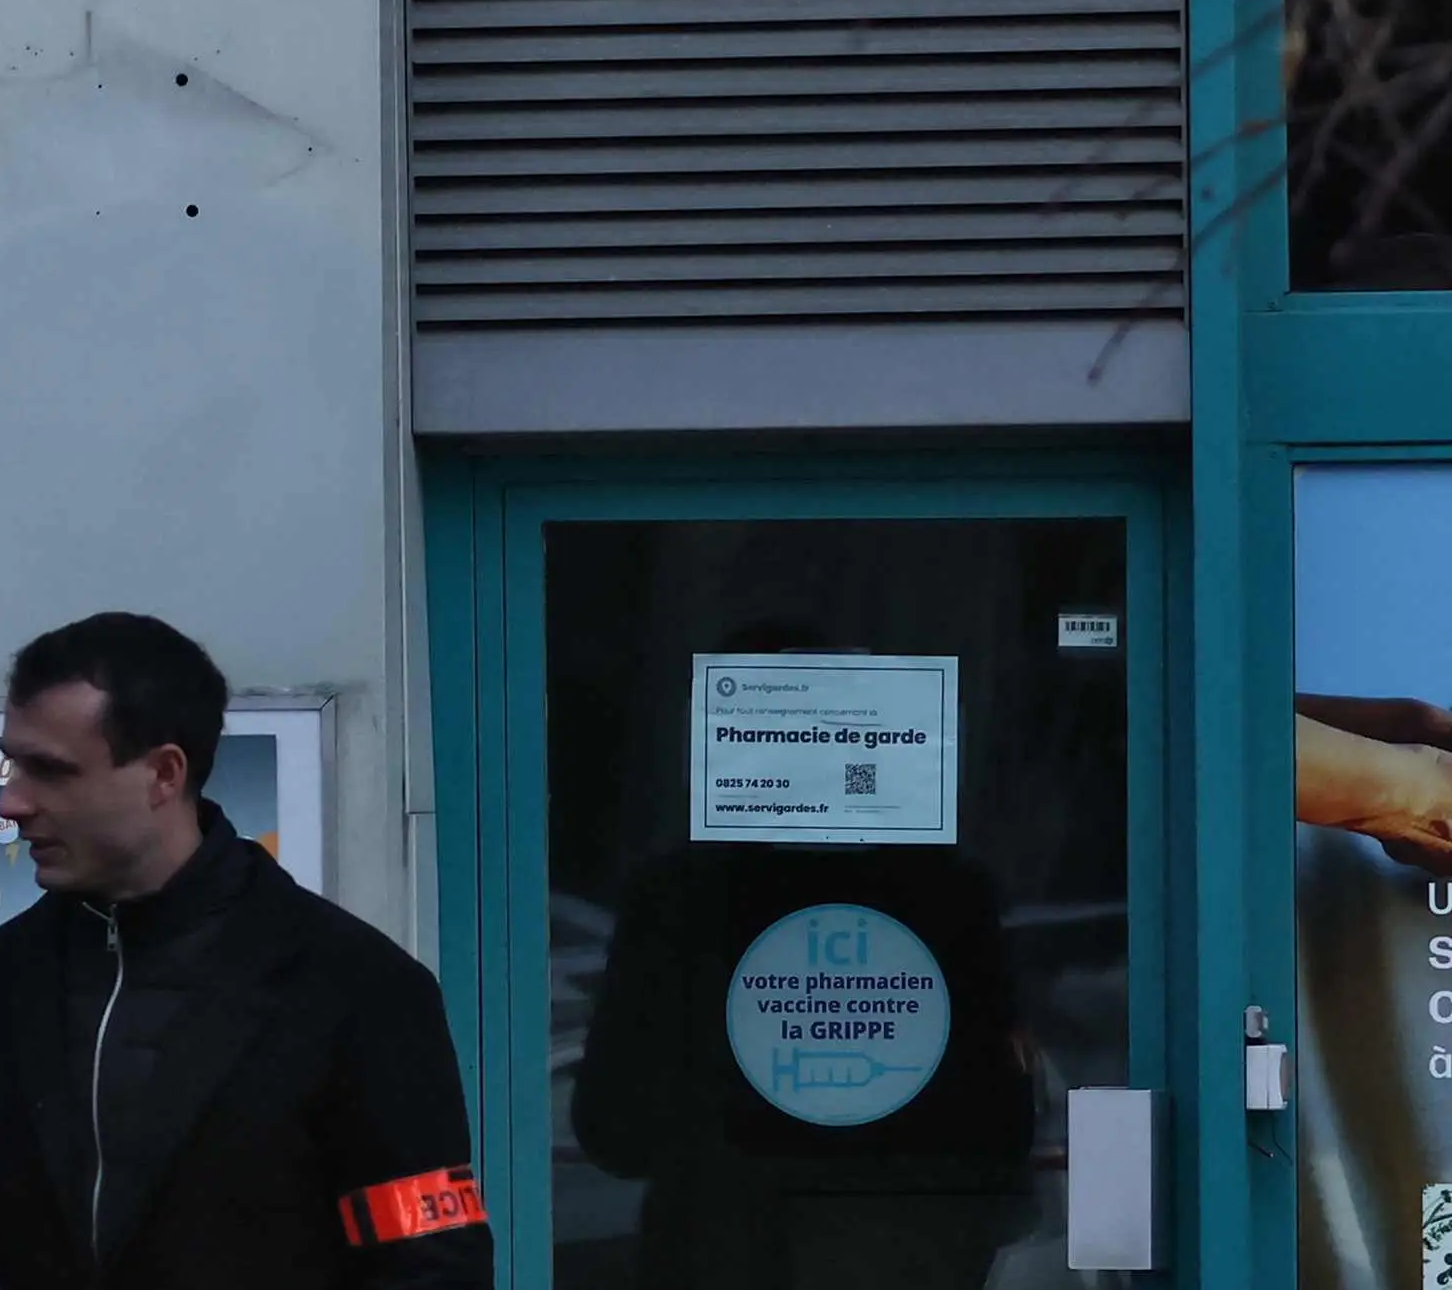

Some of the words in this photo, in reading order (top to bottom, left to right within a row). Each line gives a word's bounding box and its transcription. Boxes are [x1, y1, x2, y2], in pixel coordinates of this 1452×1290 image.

[716, 727, 830, 744] Pharmacie
[834, 727, 861, 744] de
[864, 727, 927, 749] garde
[715, 778, 744, 789] 0825
[745, 779, 759, 789] 74
[760, 779, 774, 789] 20
[775, 779, 791, 789] 30
[715, 802, 829, 815] www.servigardes.fr
[806, 918, 869, 966] ici
[742, 973, 800, 990] votre
[805, 972, 934, 994] pharmacien
[757, 996, 841, 1014] vaccine
[846, 998, 920, 1014] contre
[781, 1020, 804, 1040] la
[810, 1021, 895, 1040] GRIPPE
